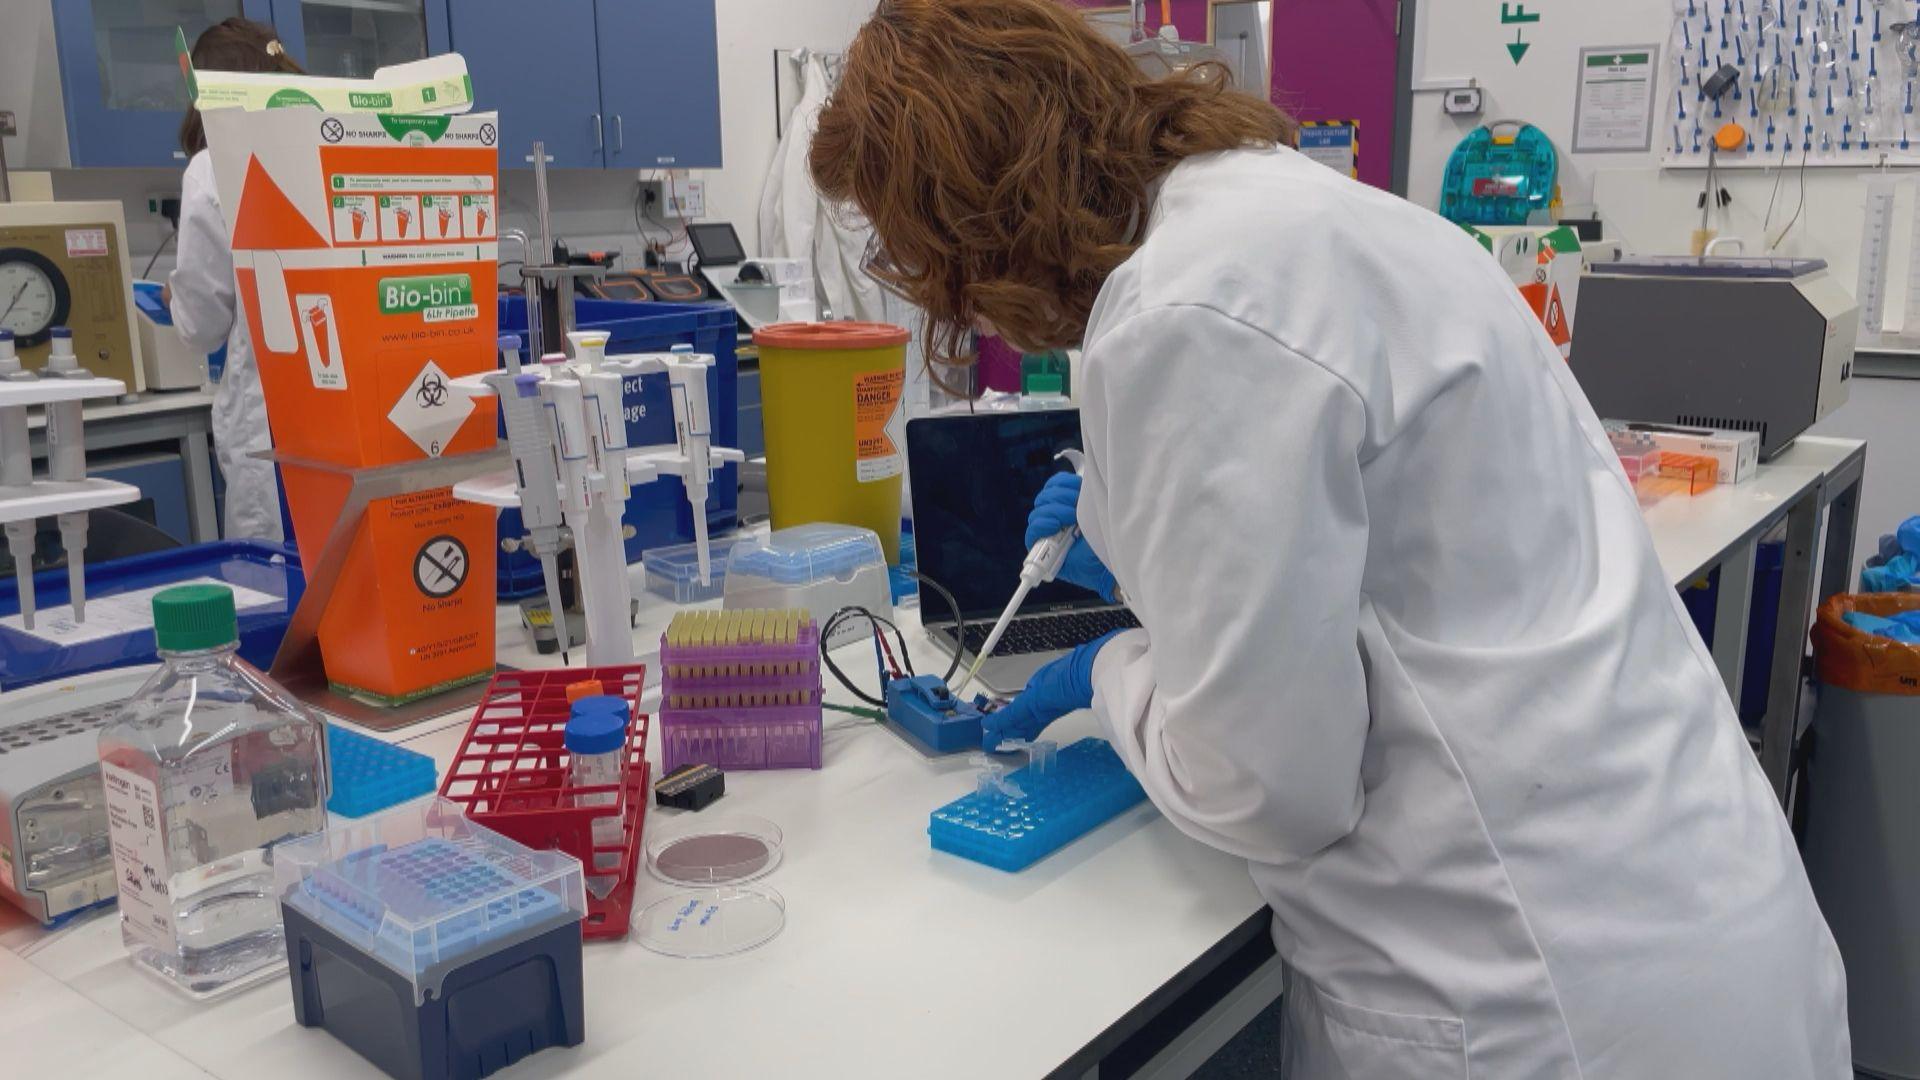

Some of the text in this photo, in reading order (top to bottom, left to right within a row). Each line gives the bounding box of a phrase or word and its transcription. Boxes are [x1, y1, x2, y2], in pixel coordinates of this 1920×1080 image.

[445, 306, 476, 318] Pipette
[858, 391, 890, 403] DANGER
[431, 440, 439, 456] 6
[422, 604, 435, 612] No
